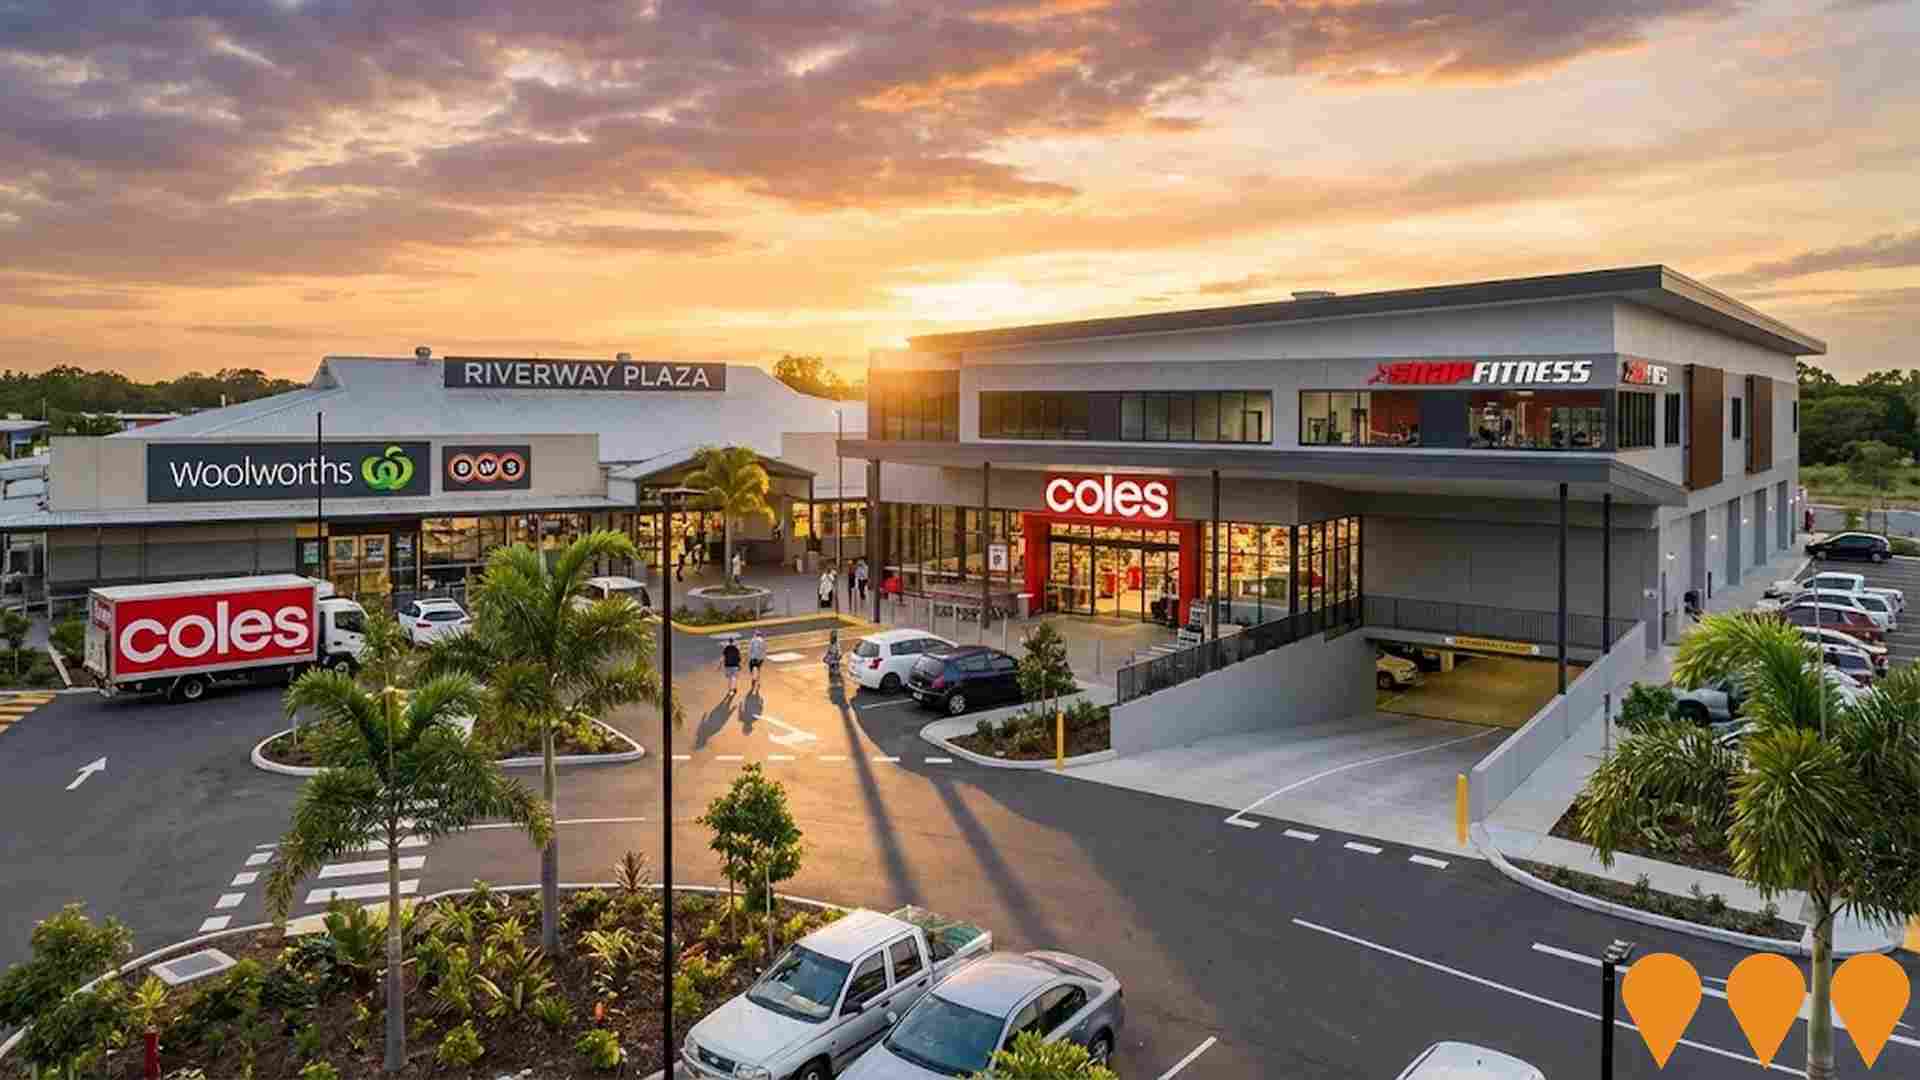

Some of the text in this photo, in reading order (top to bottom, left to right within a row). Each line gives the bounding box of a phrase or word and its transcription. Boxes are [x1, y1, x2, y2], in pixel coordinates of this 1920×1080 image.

[464, 362, 711, 388] RIVERWAY PLAZA
[1472, 360, 1592, 383] FITNESS
[169, 455, 353, 489] Woolworths
[1046, 474, 1169, 518] coles
[119, 601, 309, 663] coles
